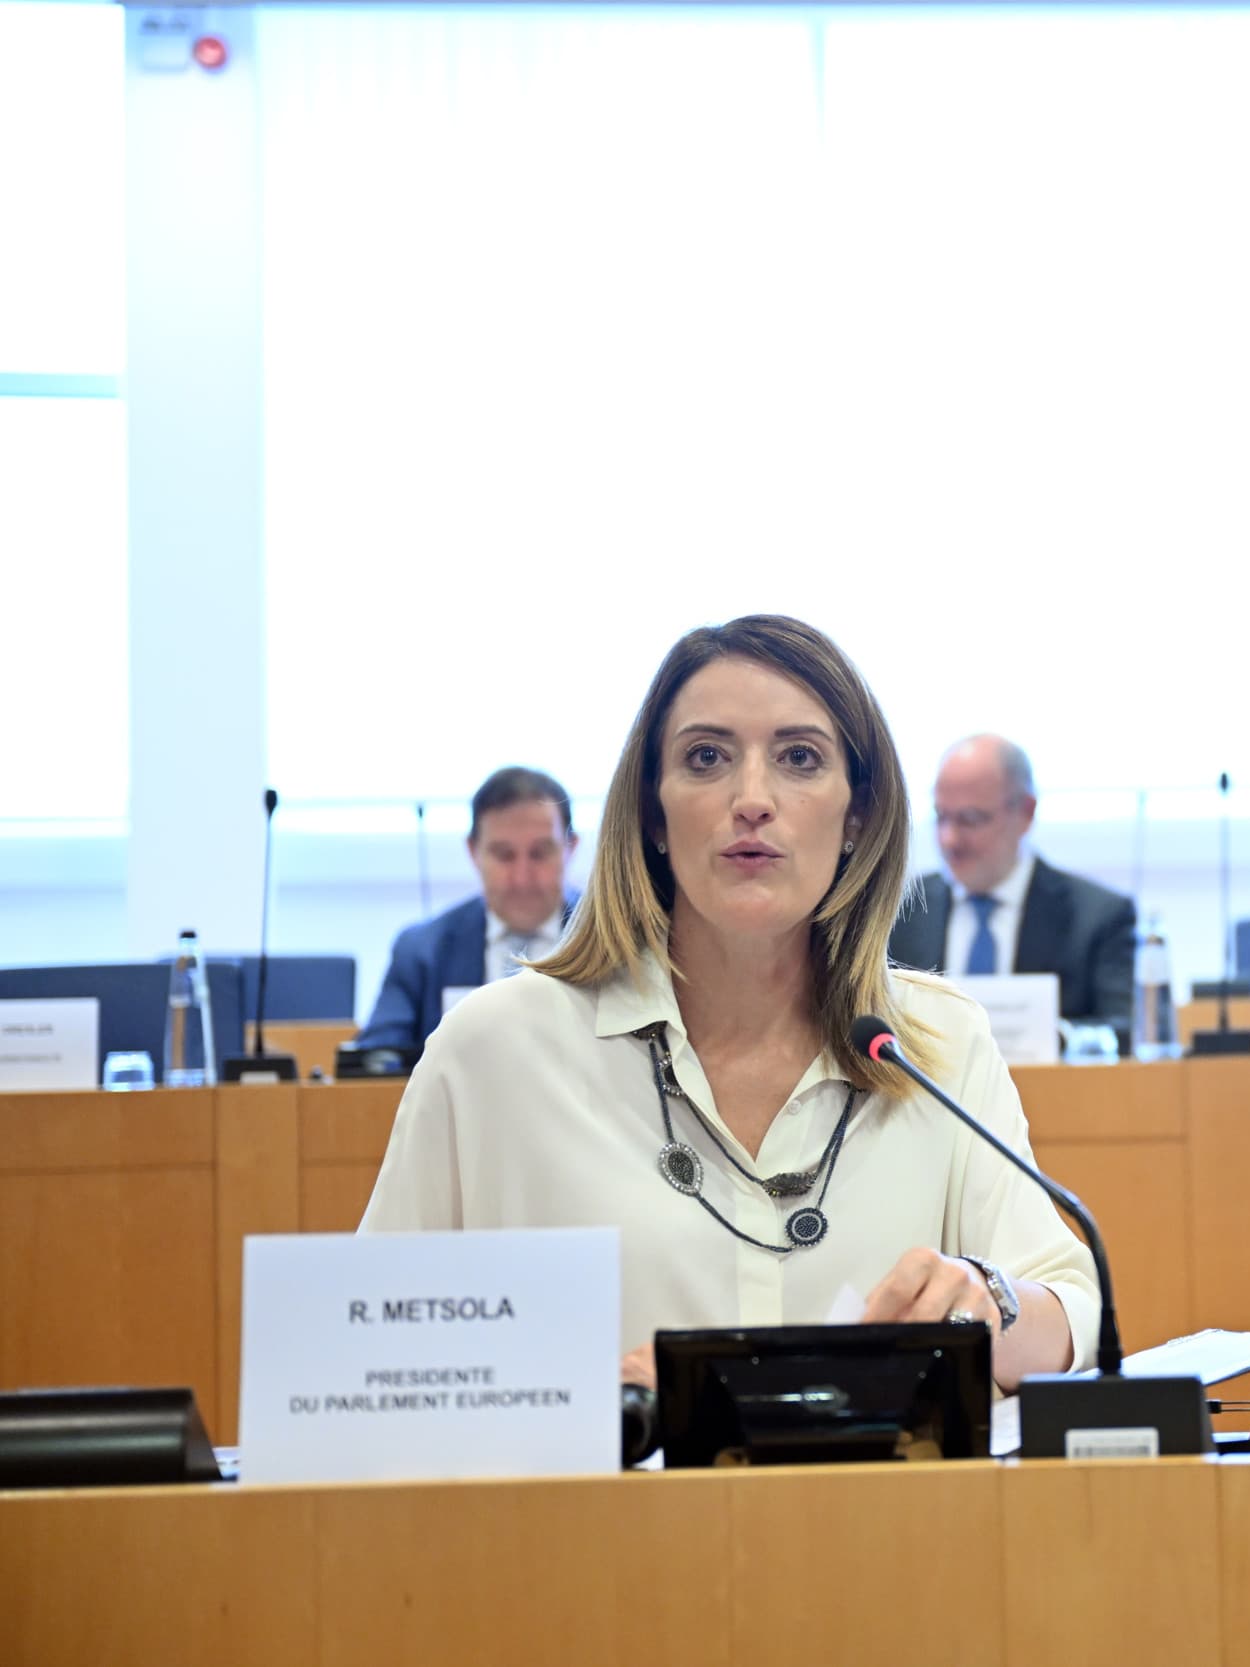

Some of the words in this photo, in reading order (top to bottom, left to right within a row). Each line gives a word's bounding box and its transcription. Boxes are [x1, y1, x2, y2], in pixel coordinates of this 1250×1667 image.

[348, 1299, 372, 1324] R.
[382, 1296, 516, 1323] METSOLA
[364, 1366, 494, 1388] PRESIDENTE
[289, 1396, 320, 1414] DU
[324, 1392, 450, 1413] PARLEMENT
[455, 1389, 571, 1409] EUROPEEN
